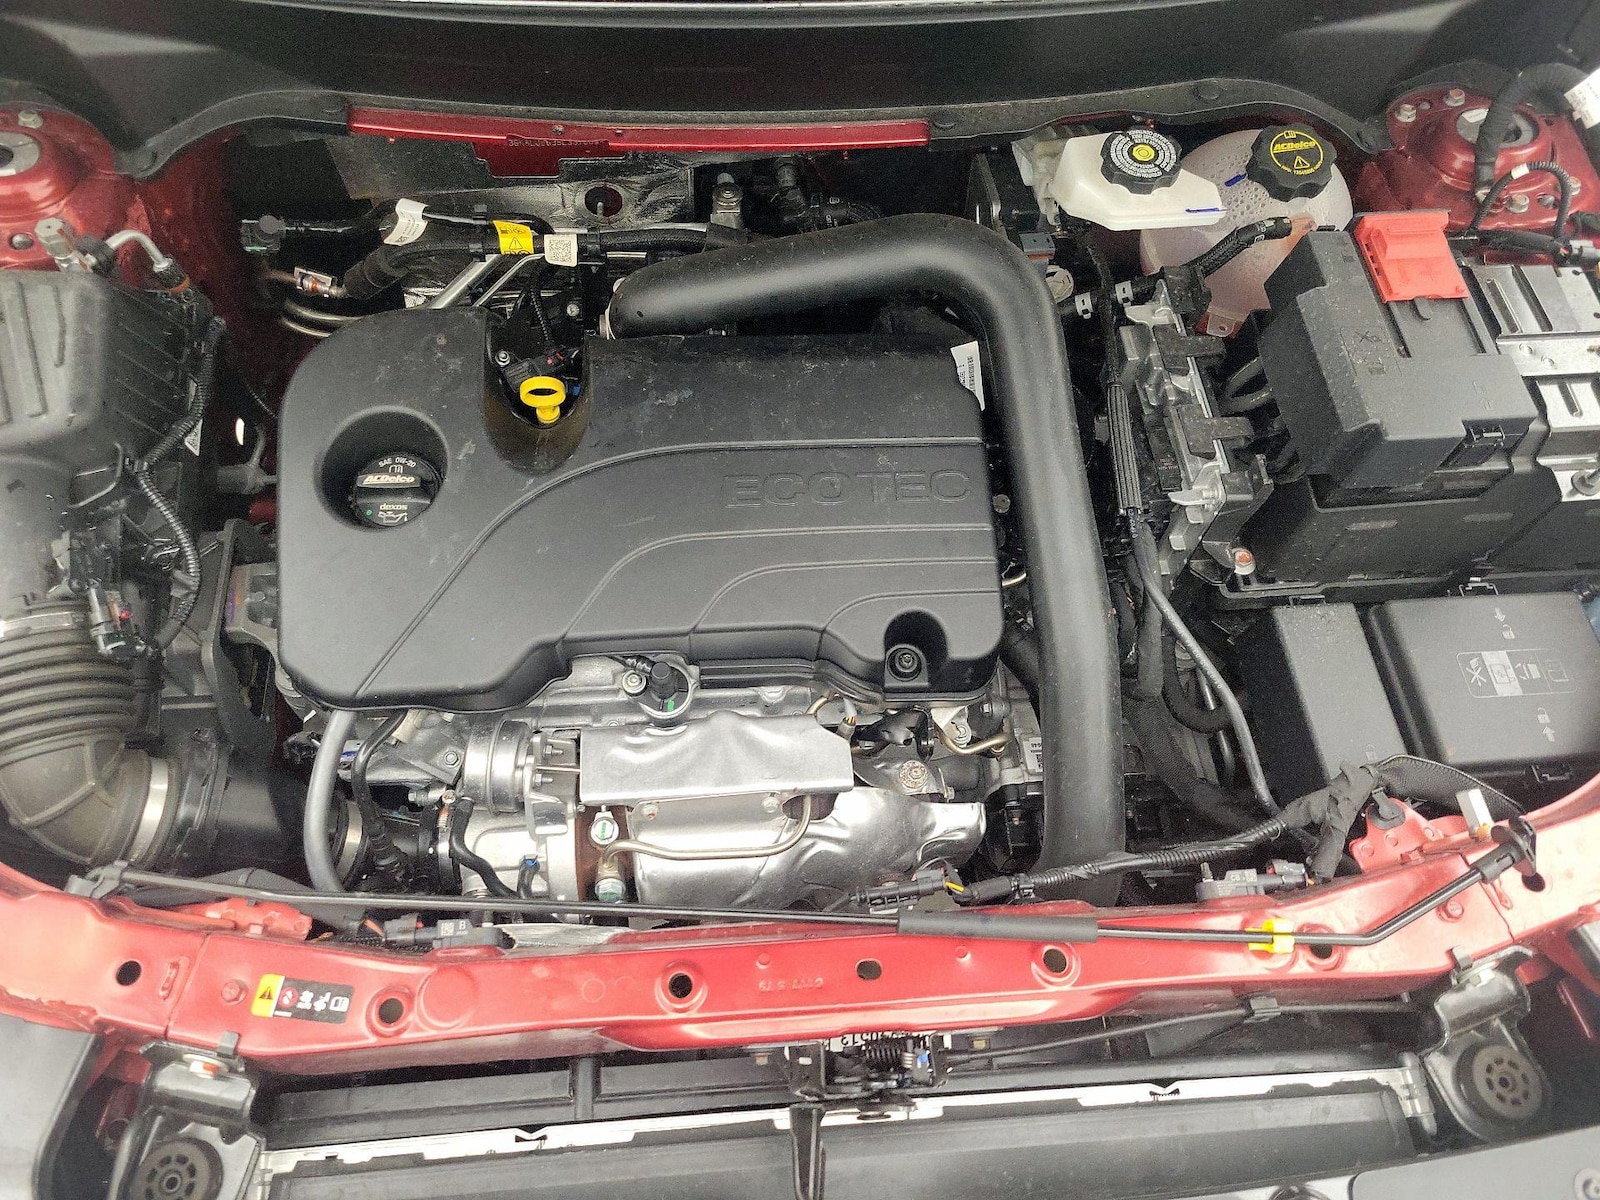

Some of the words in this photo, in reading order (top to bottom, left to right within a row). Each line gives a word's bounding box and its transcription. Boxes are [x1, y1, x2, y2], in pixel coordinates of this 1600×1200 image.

[1273, 141, 1316, 153] ACDelco
[379, 458, 392, 467] SAE
[363, 474, 415, 485] ACDelco
[721, 469, 971, 508] ECOTEC
